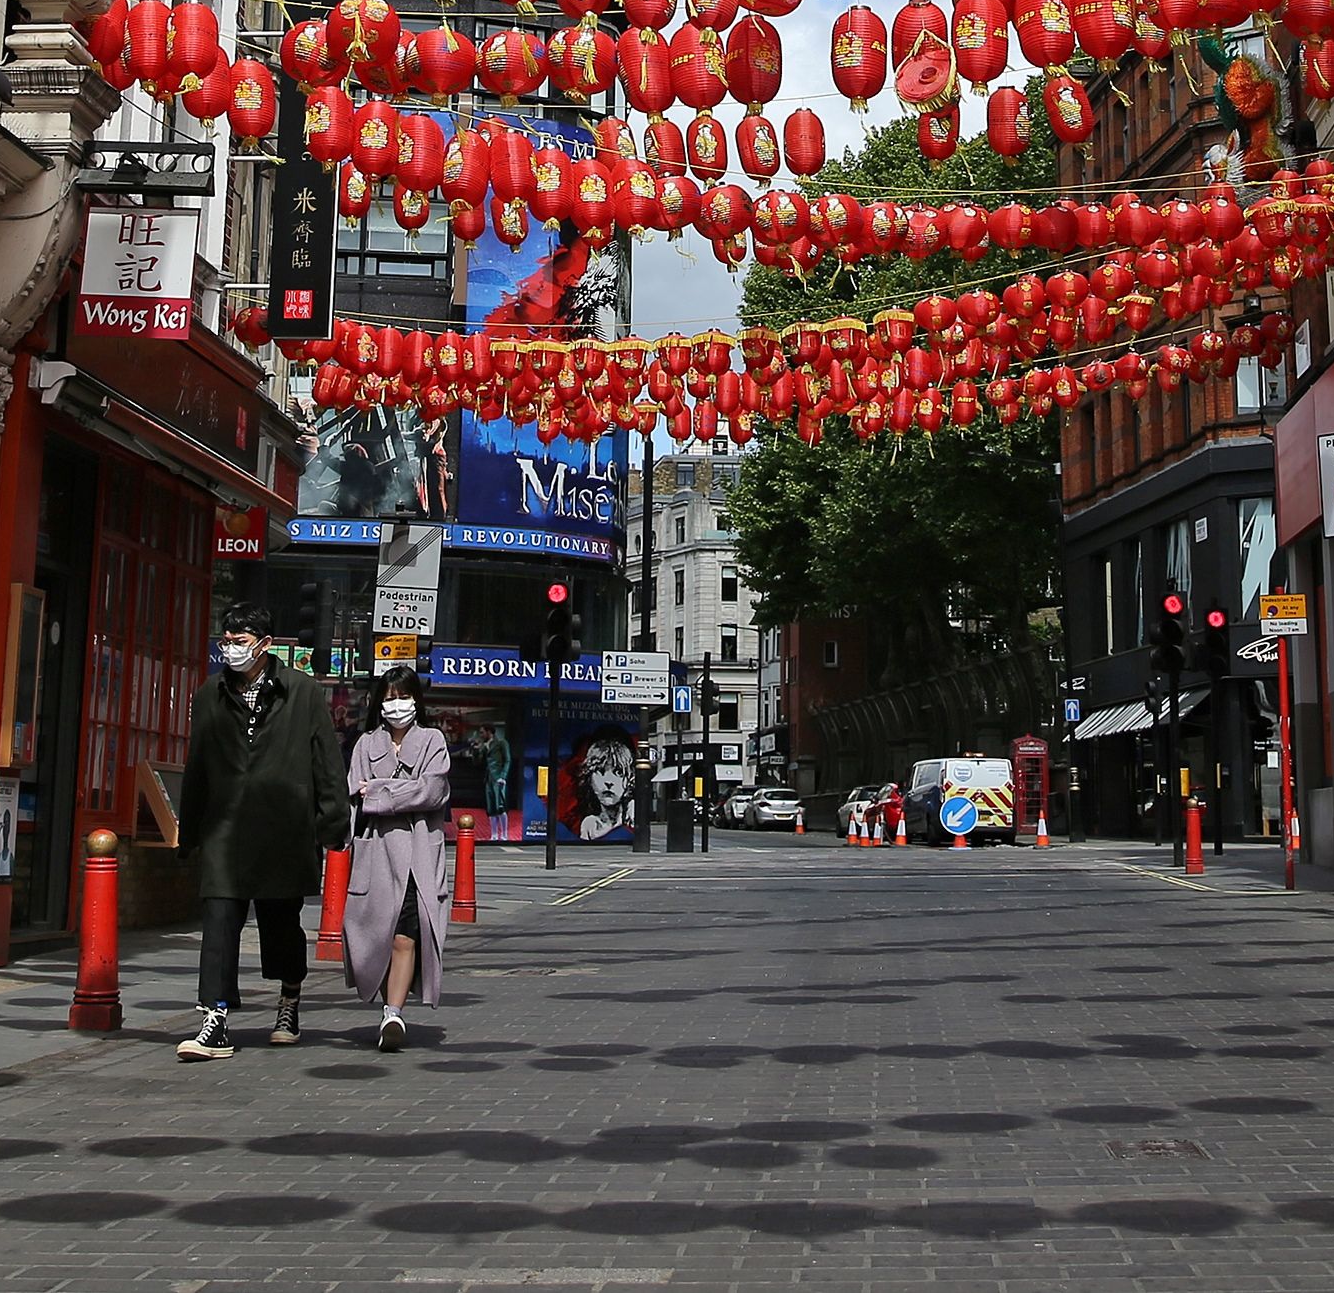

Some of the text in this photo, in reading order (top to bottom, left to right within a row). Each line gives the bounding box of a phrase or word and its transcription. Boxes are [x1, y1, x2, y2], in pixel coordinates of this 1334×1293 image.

[114, 213, 165, 293] 旺記
[83, 299, 188, 332] Wong Kei
[311, 524, 351, 538] MIZ
[218, 538, 260, 553] LEON
[462, 529, 608, 555] REVOLUTIONARY
[379, 590, 434, 603] Pedestrian
[380, 615, 428, 631] ENDS
[442, 657, 536, 678] REBORN
[634, 675, 657, 683] Brewer
[618, 691, 652, 699] Chinatown
